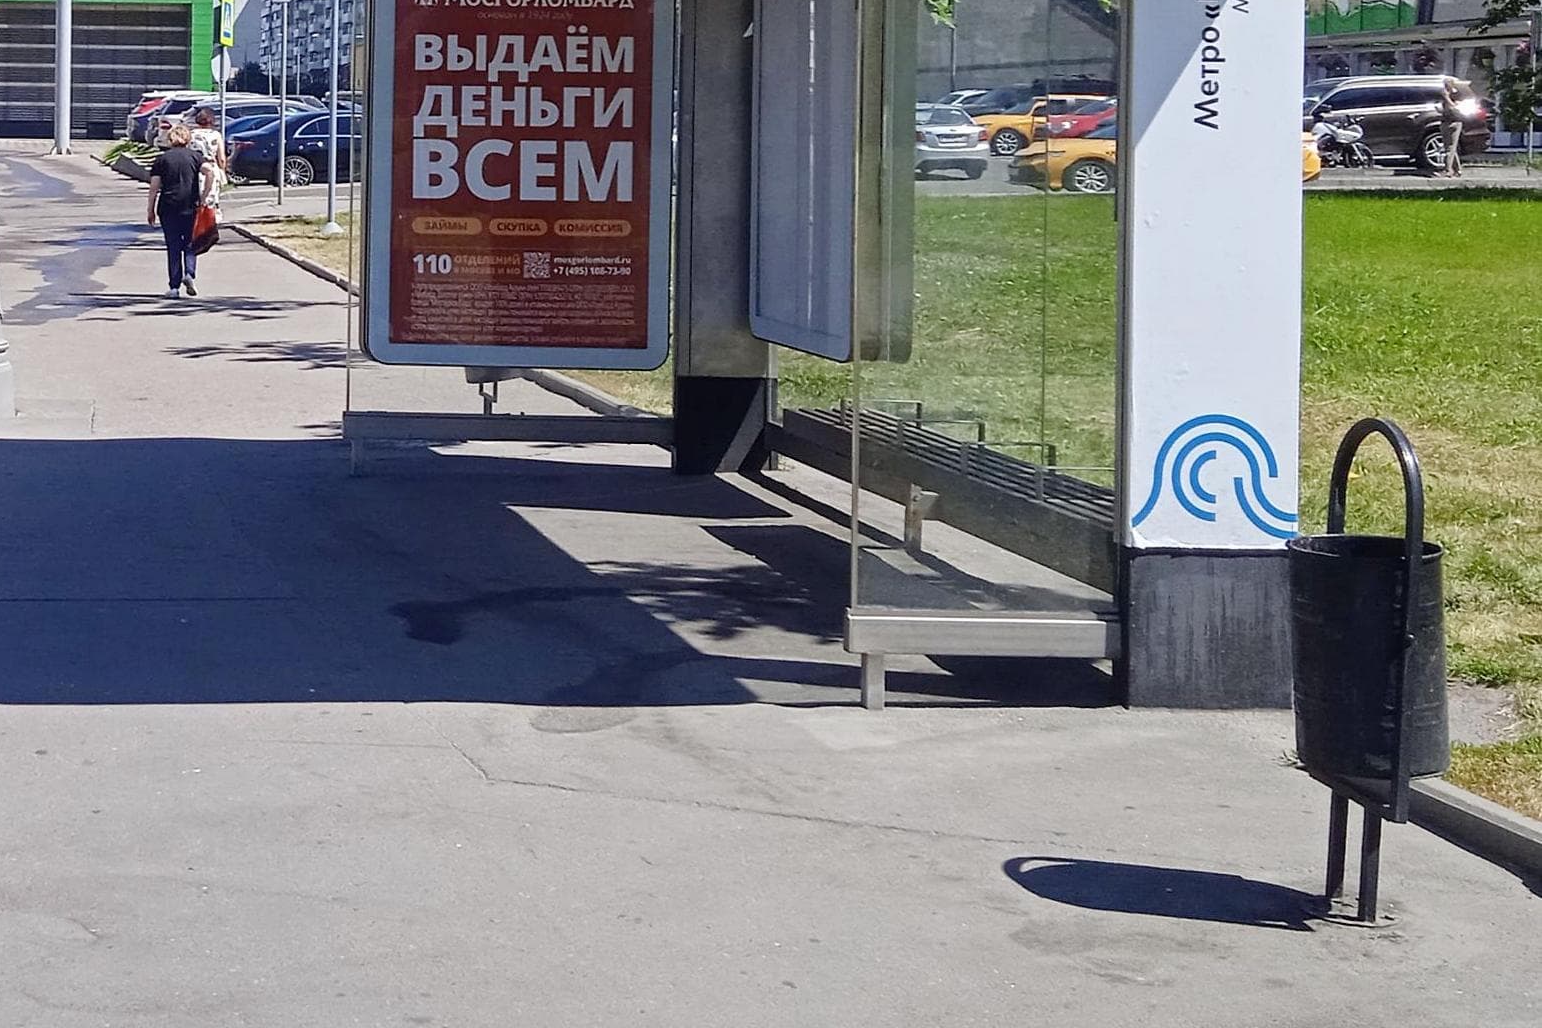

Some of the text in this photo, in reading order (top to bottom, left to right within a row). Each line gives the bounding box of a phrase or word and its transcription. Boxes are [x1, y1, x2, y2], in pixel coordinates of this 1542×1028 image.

[414, 25, 635, 82] ВЫДАЁМ
[1193, 26, 1226, 130] Метро
[413, 85, 634, 138] ДЕНЬГИ
[412, 138, 634, 203] ВСЕМ
[424, 218, 468, 231] ЗАЙМЫ
[496, 222, 541, 233] СКУПКА
[559, 223, 624, 234] КОМИССИЯ
[413, 253, 452, 274] 110
